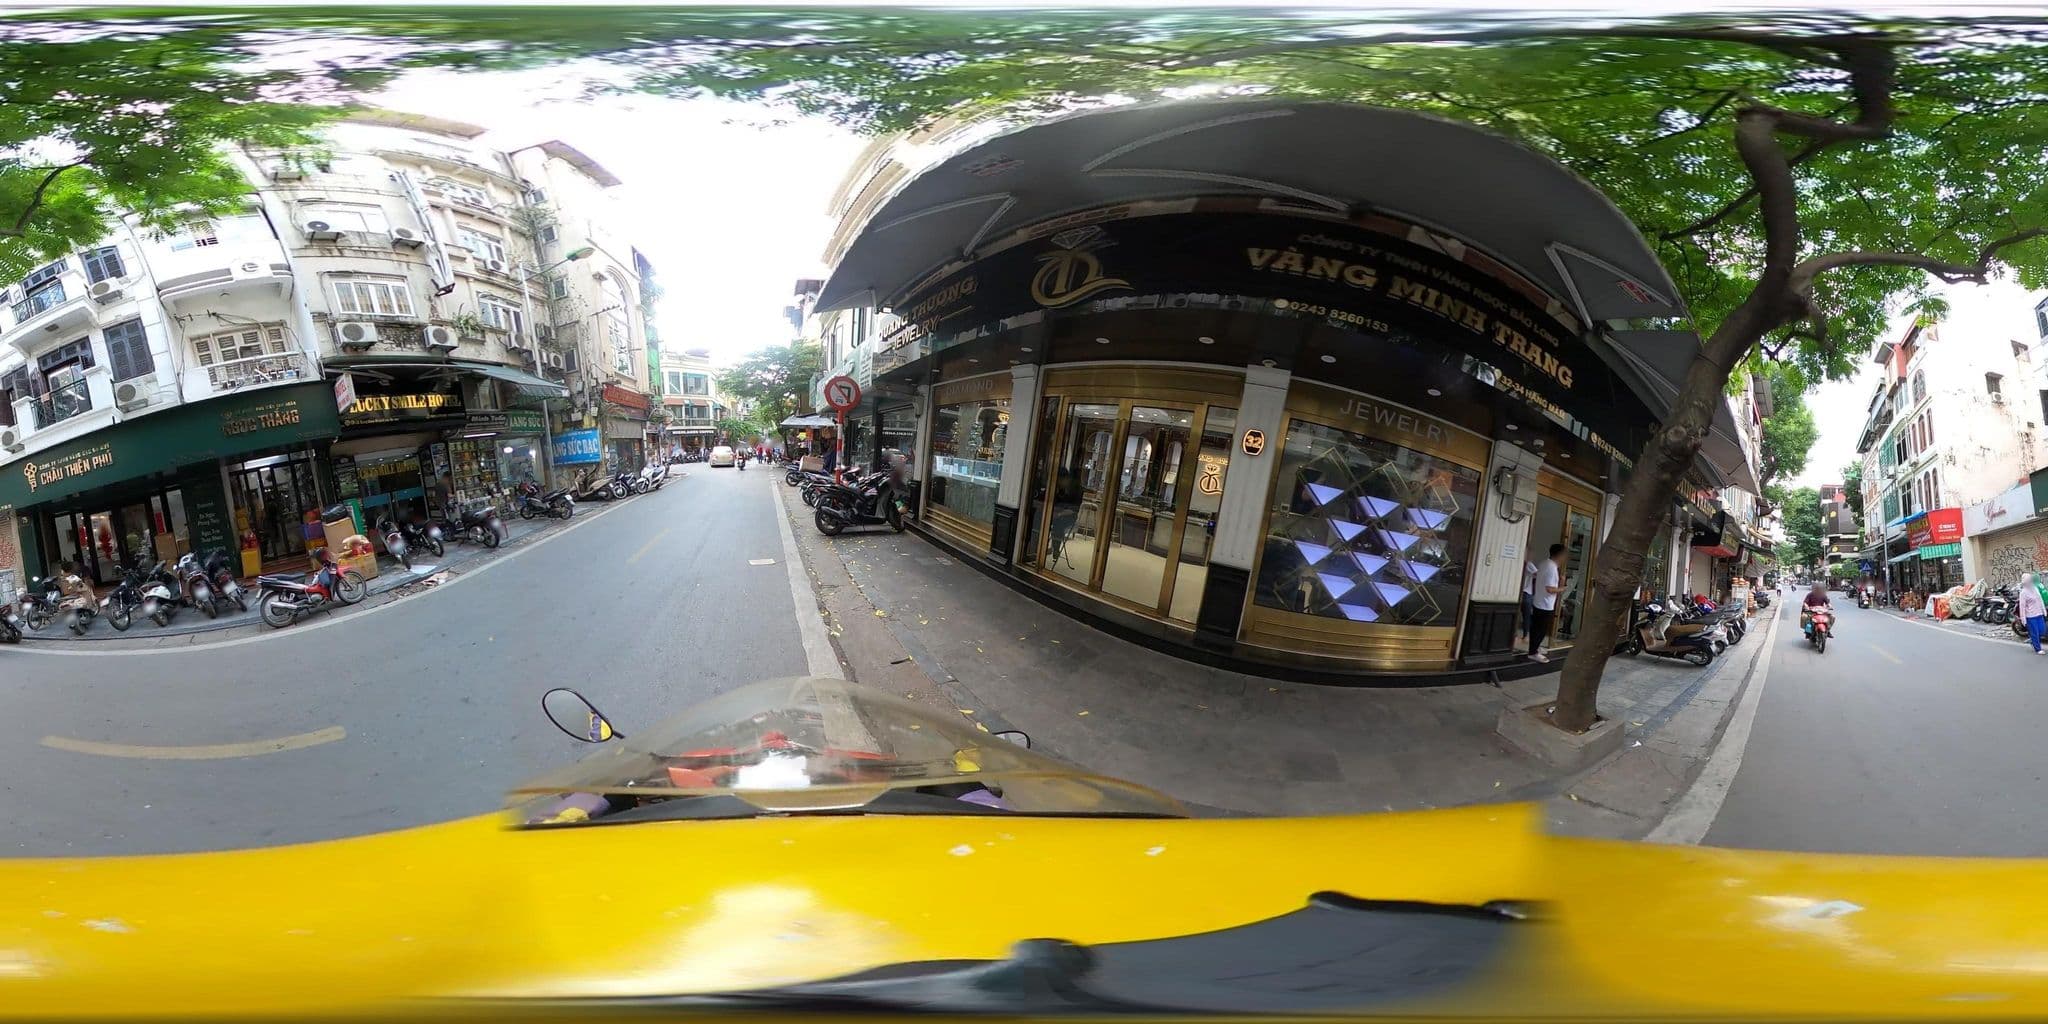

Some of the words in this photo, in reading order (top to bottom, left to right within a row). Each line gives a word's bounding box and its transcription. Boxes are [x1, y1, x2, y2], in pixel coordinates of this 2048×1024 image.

[1247, 245, 1378, 291] VÀNG
[1385, 275, 1488, 334] MINH
[1491, 320, 1574, 389] TRANG
[1290, 301, 1326, 316] 0243
[1329, 309, 1389, 333] 8260153
[1501, 376, 1525, 395] 32-34
[349, 396, 390, 414] LUCKY
[392, 393, 427, 410] SMILE
[427, 392, 462, 409] HOTEL
[1340, 399, 1456, 448] JEWELRY
[1245, 434, 1262, 449] 32
[40, 466, 64, 485] CHÂU
[65, 458, 91, 477] THIỆN
[92, 449, 114, 469] PHÚ
